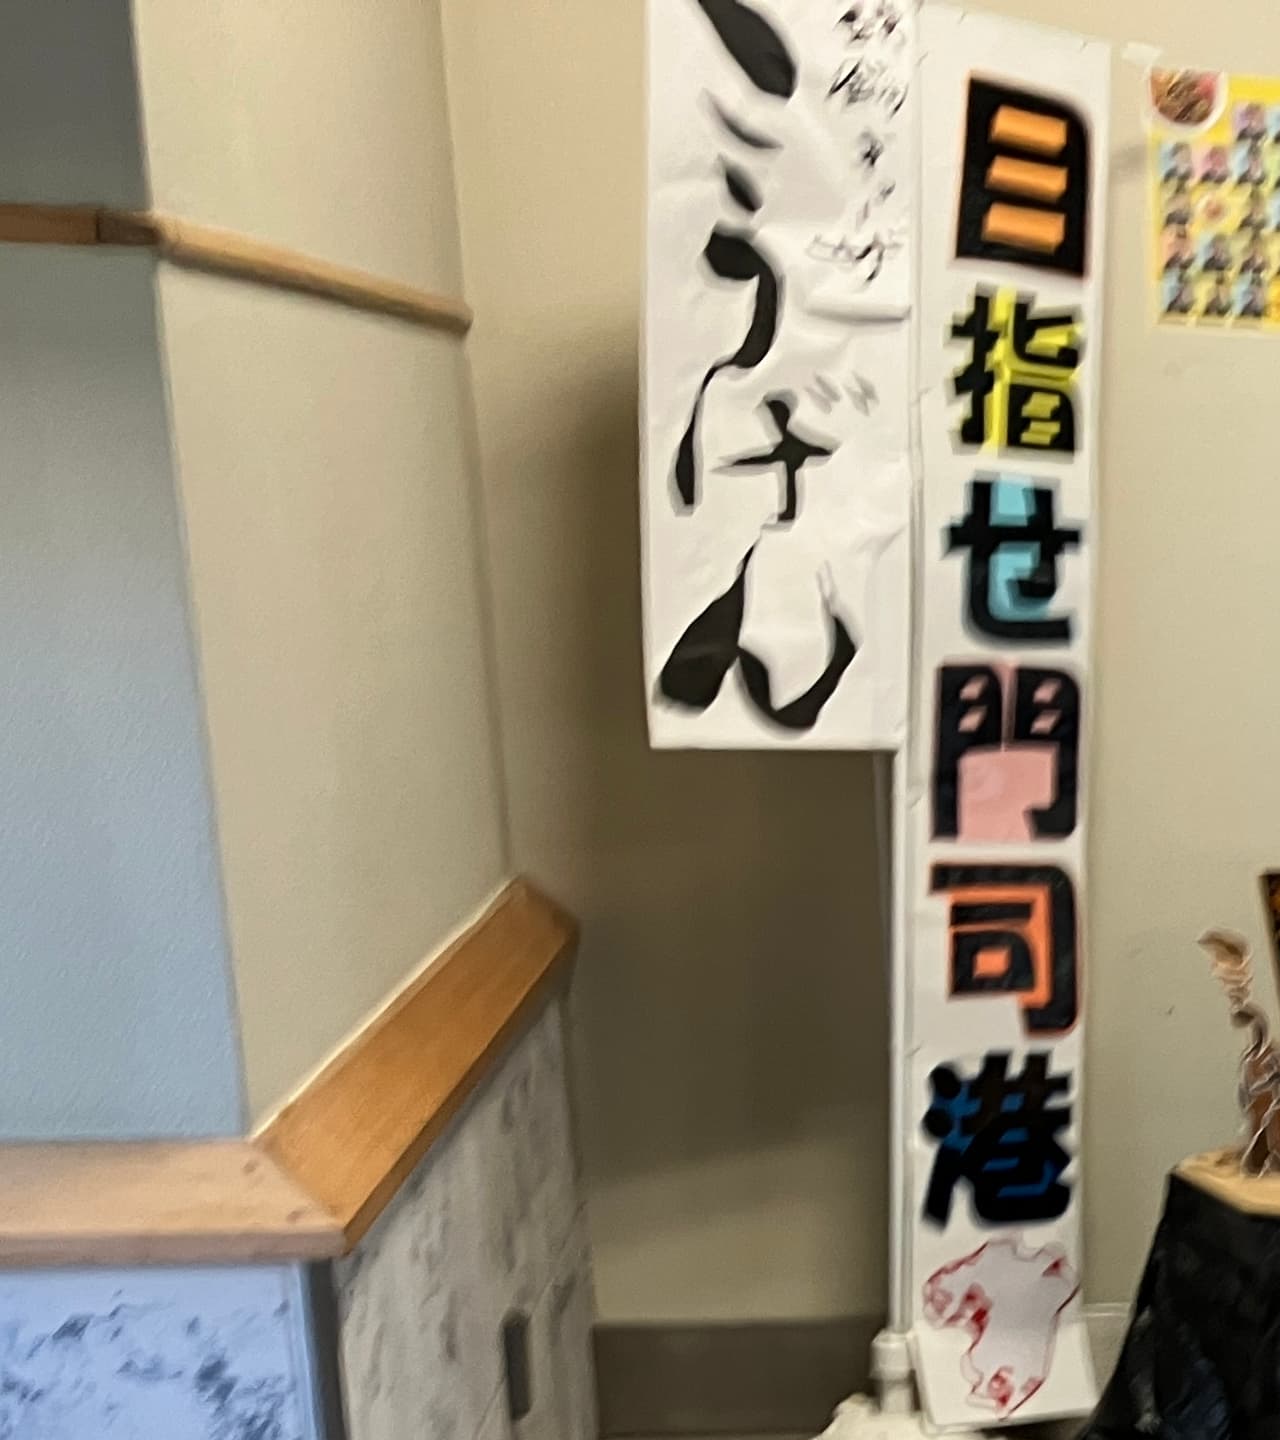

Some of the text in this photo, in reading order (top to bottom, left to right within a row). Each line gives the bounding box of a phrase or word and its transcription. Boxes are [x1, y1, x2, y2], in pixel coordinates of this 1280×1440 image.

[921, 70, 1093, 1228] 目指せ門司港
